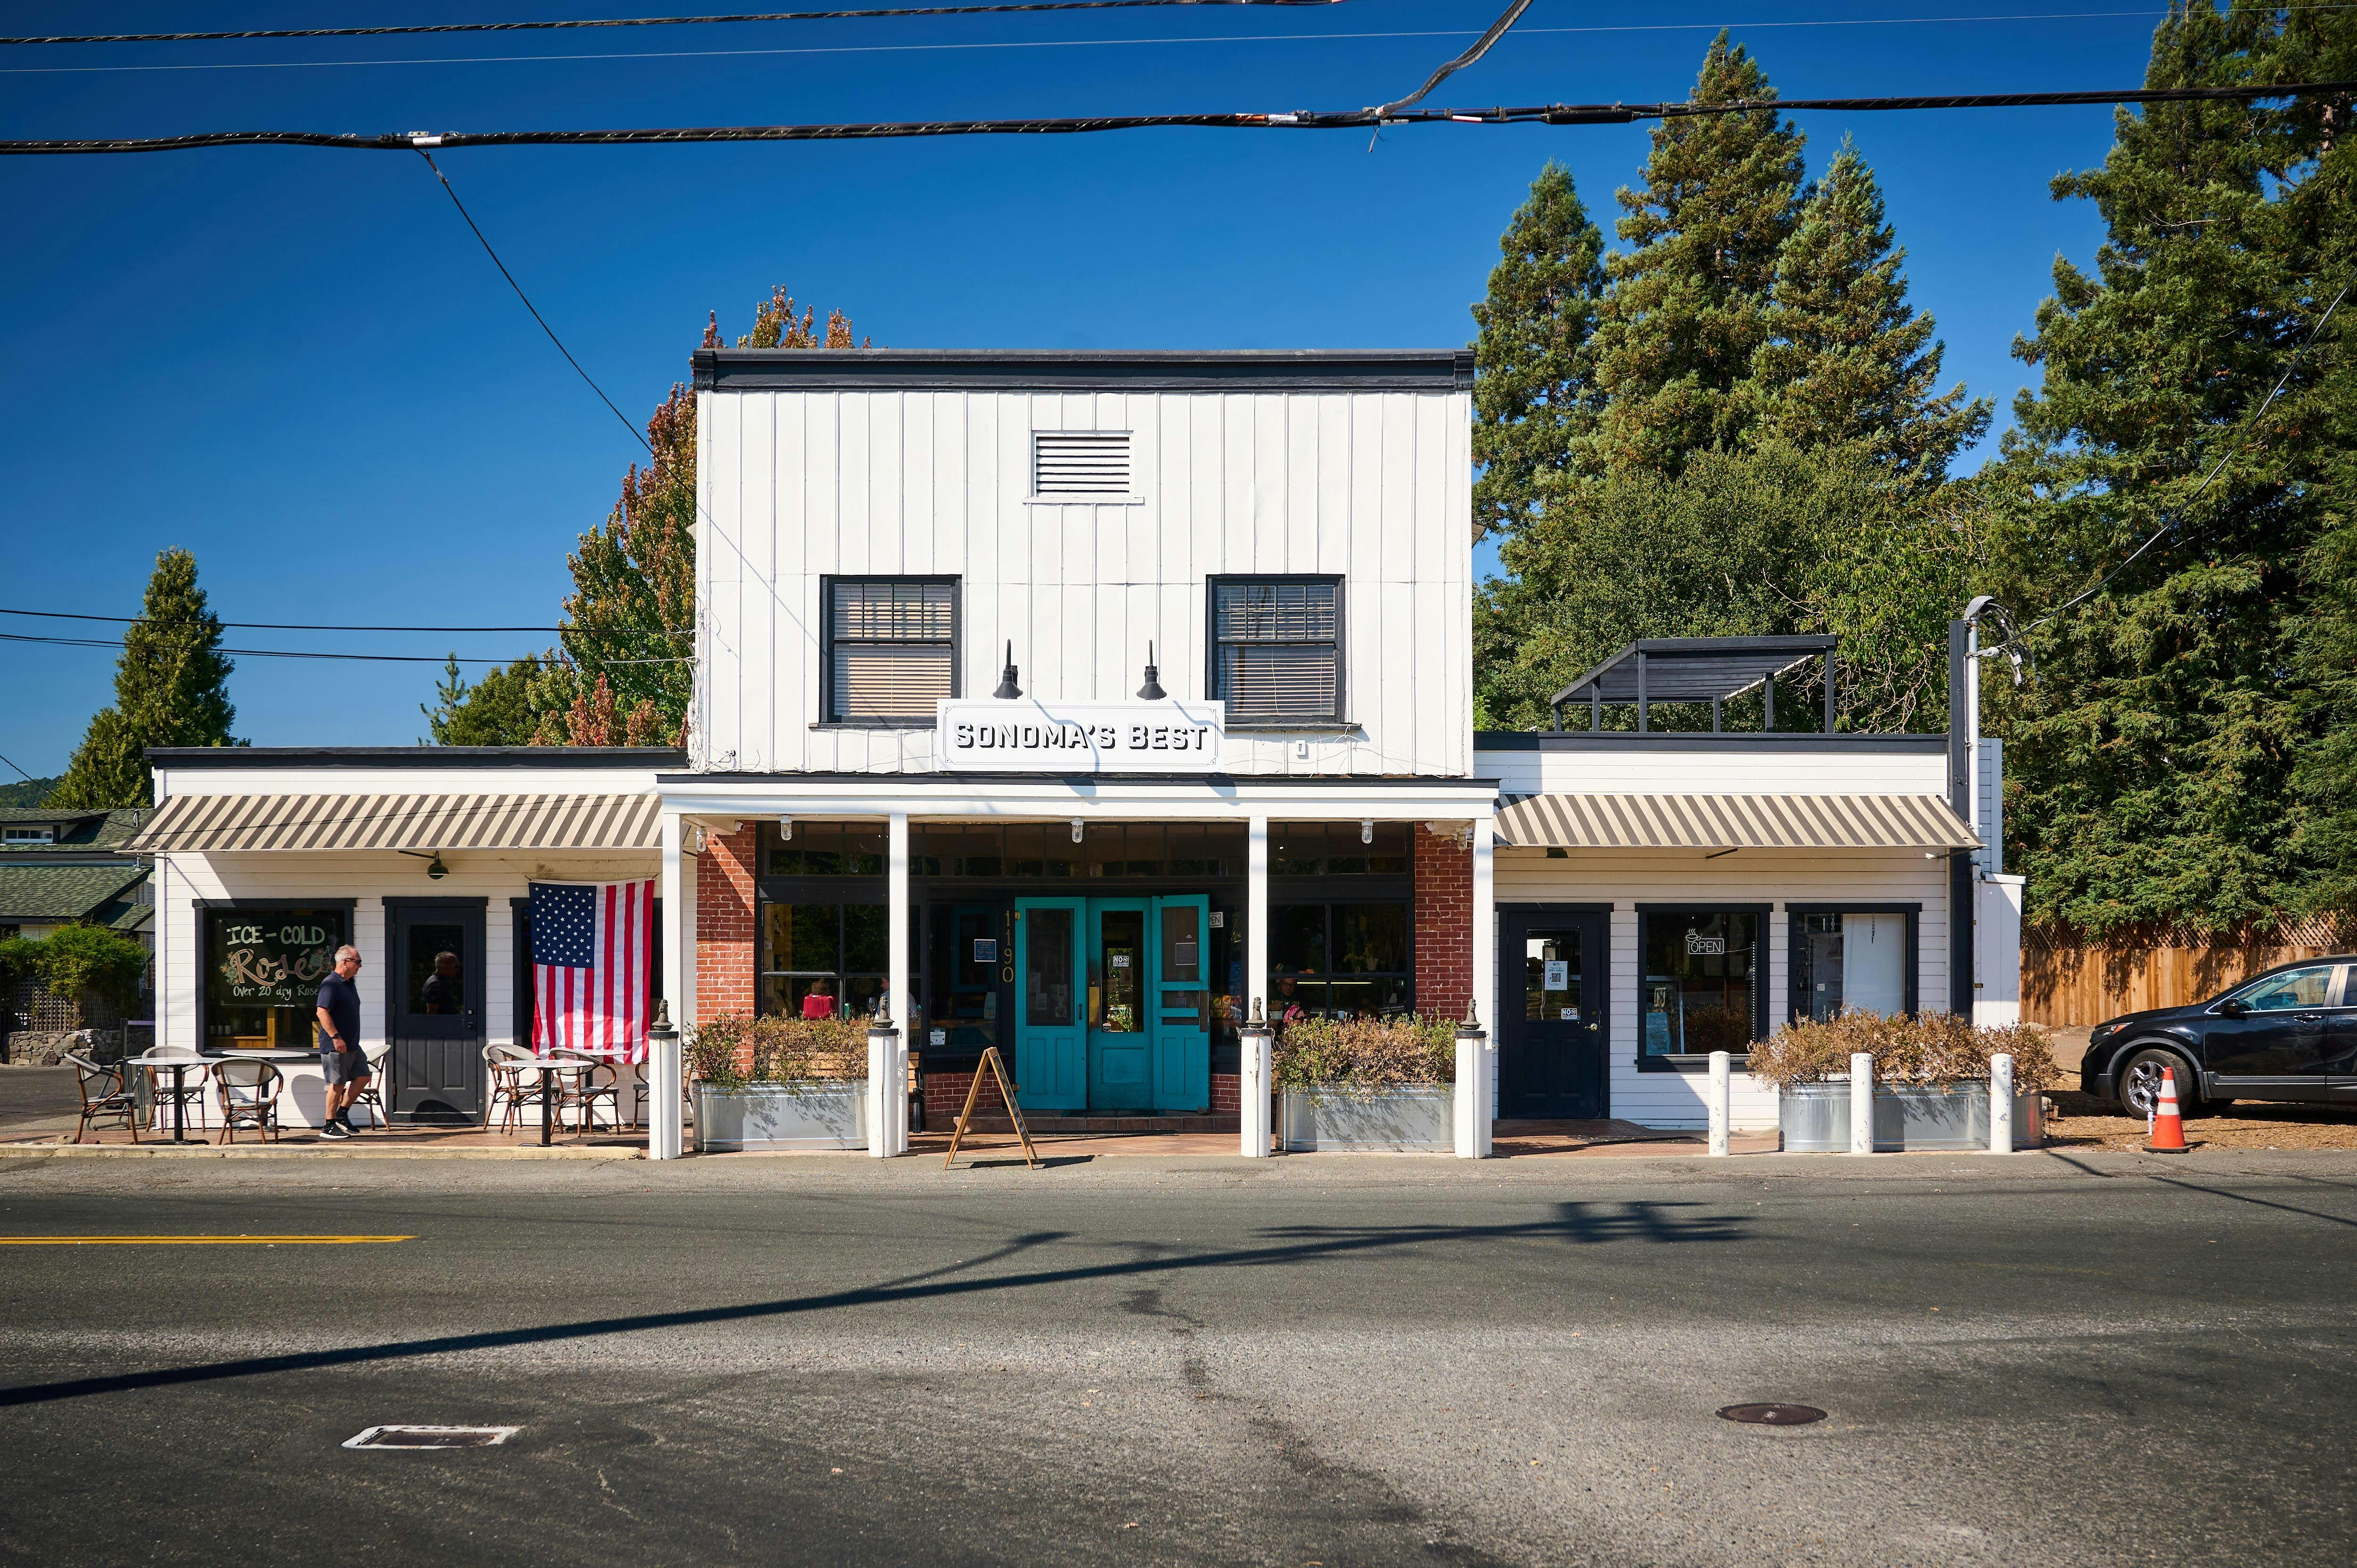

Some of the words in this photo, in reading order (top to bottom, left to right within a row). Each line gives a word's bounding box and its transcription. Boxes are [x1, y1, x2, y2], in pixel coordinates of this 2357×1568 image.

[953, 720, 1115, 749] SONOMA'S
[1128, 722, 1208, 750] BEST
[1002, 910, 1014, 982] 1190
[1691, 941, 1721, 953] OPEN
[230, 948, 323, 987] Rosé
[233, 986, 255, 997] Over
[258, 985, 271, 996] 20
[276, 985, 292, 1001] dry
